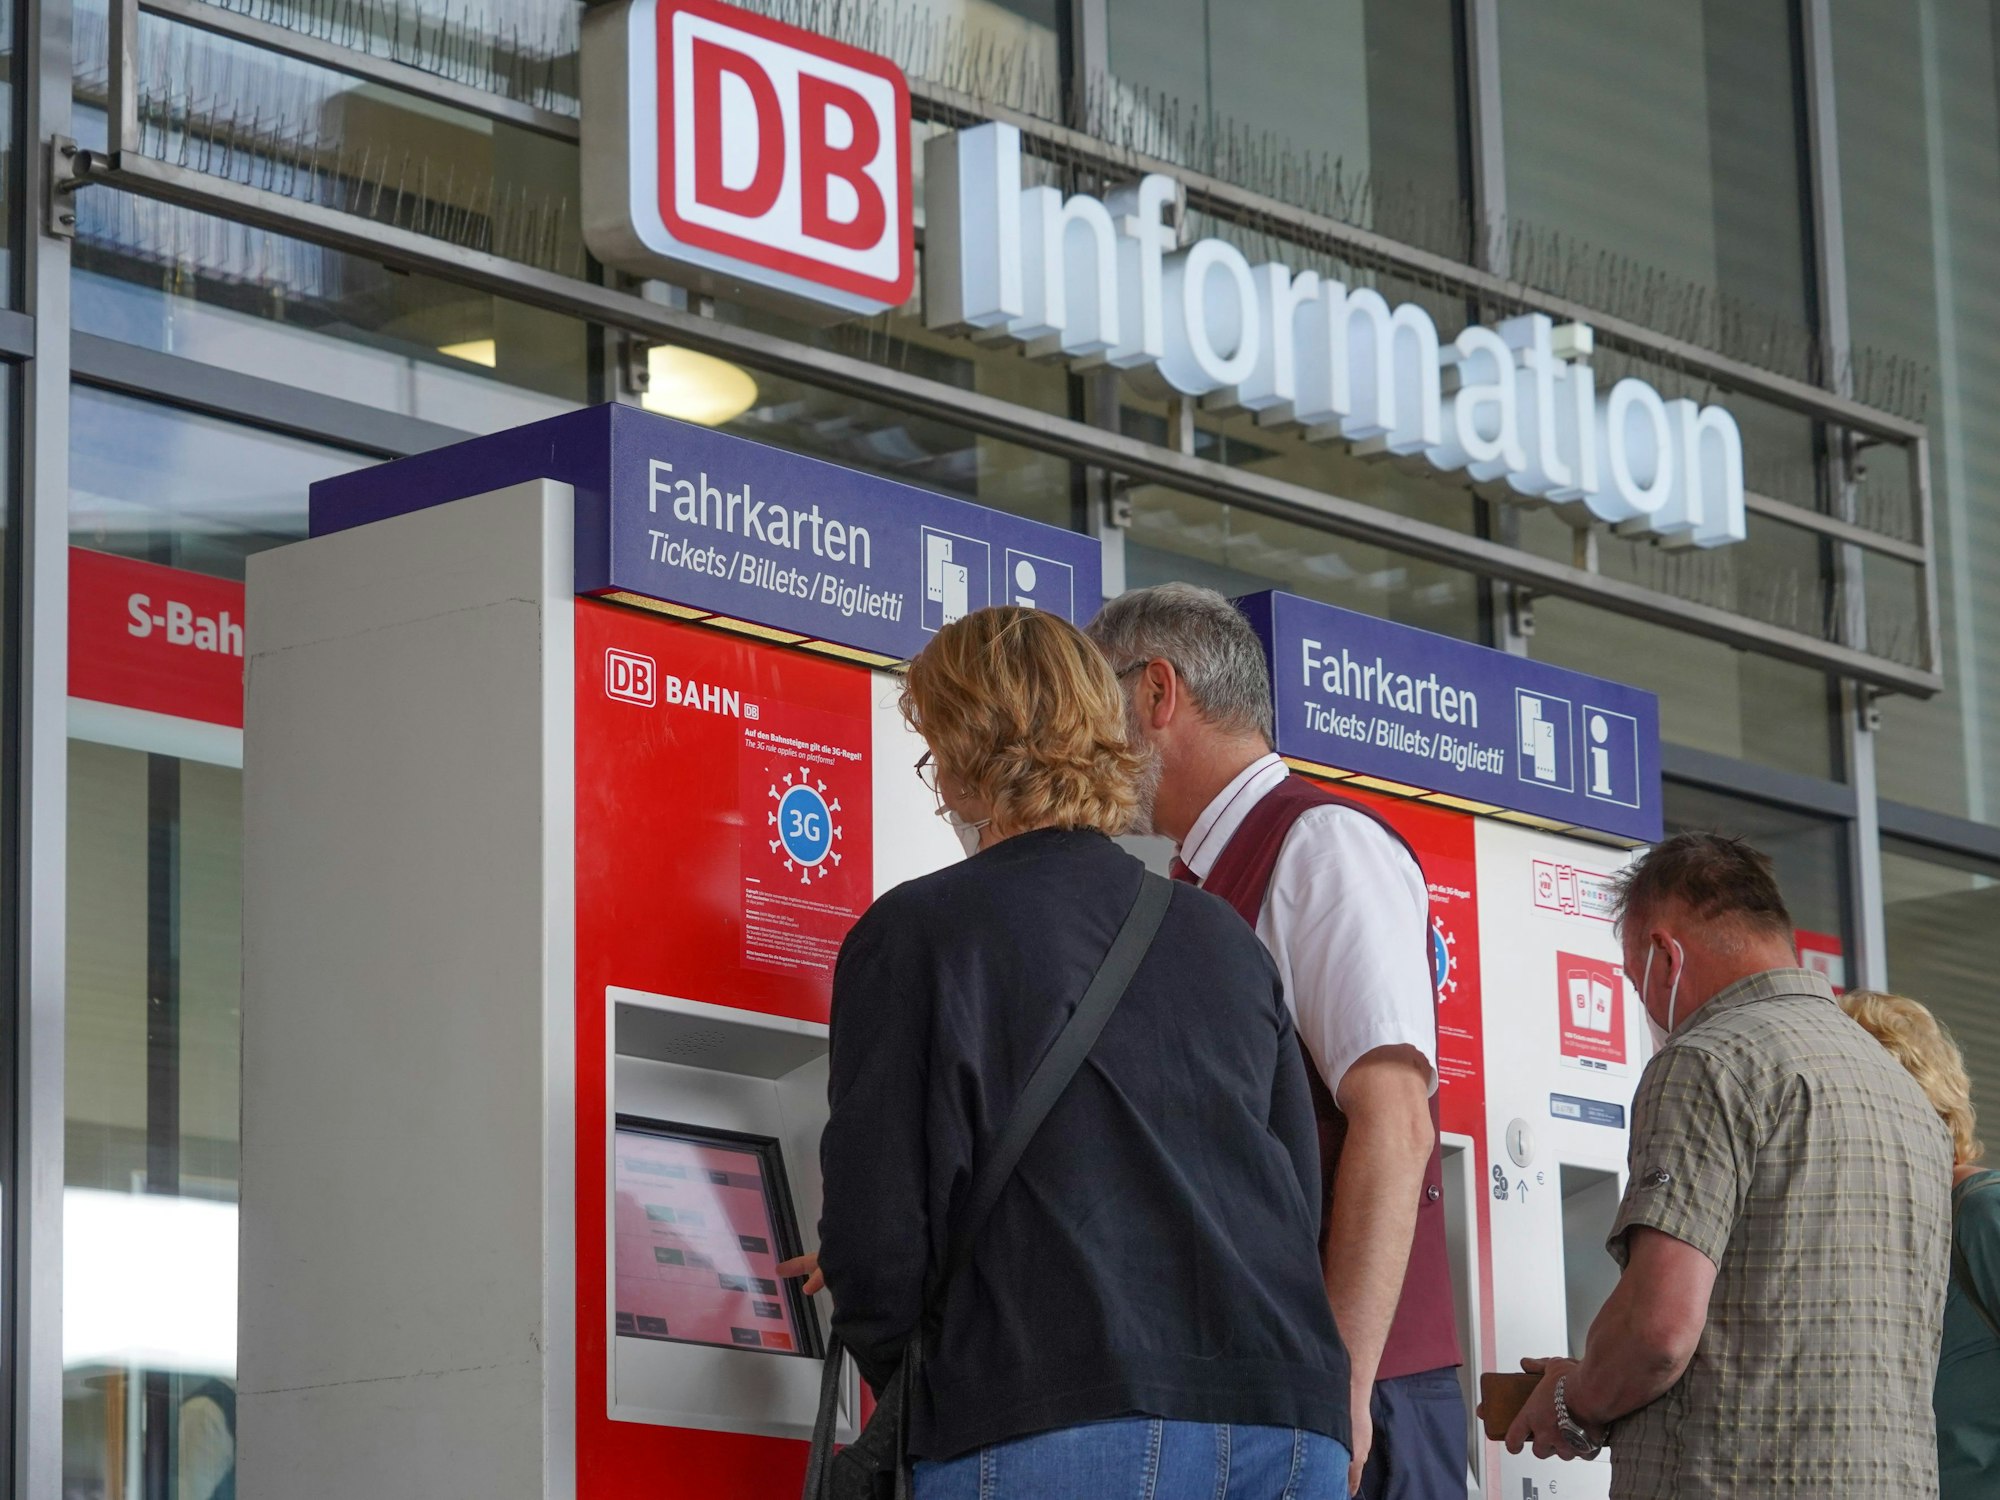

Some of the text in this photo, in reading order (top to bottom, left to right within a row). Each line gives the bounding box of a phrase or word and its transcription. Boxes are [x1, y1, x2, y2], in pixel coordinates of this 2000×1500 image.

[692, 35, 887, 252] DB
[960, 120, 1746, 546] Information
[648, 458, 871, 569] Fahrkarten
[127, 592, 243, 657] S-Bah
[612, 658, 740, 719] DB BAHN
[745, 705, 758, 718] DB
[1302, 638, 1478, 728] Fahrkarten
[744, 728, 862, 761] Auf den Bahnsteigen gilt die 3G-Regel!
[745, 739, 836, 766] The 3G rule applies on platforms!
[788, 809, 821, 843] 3G
